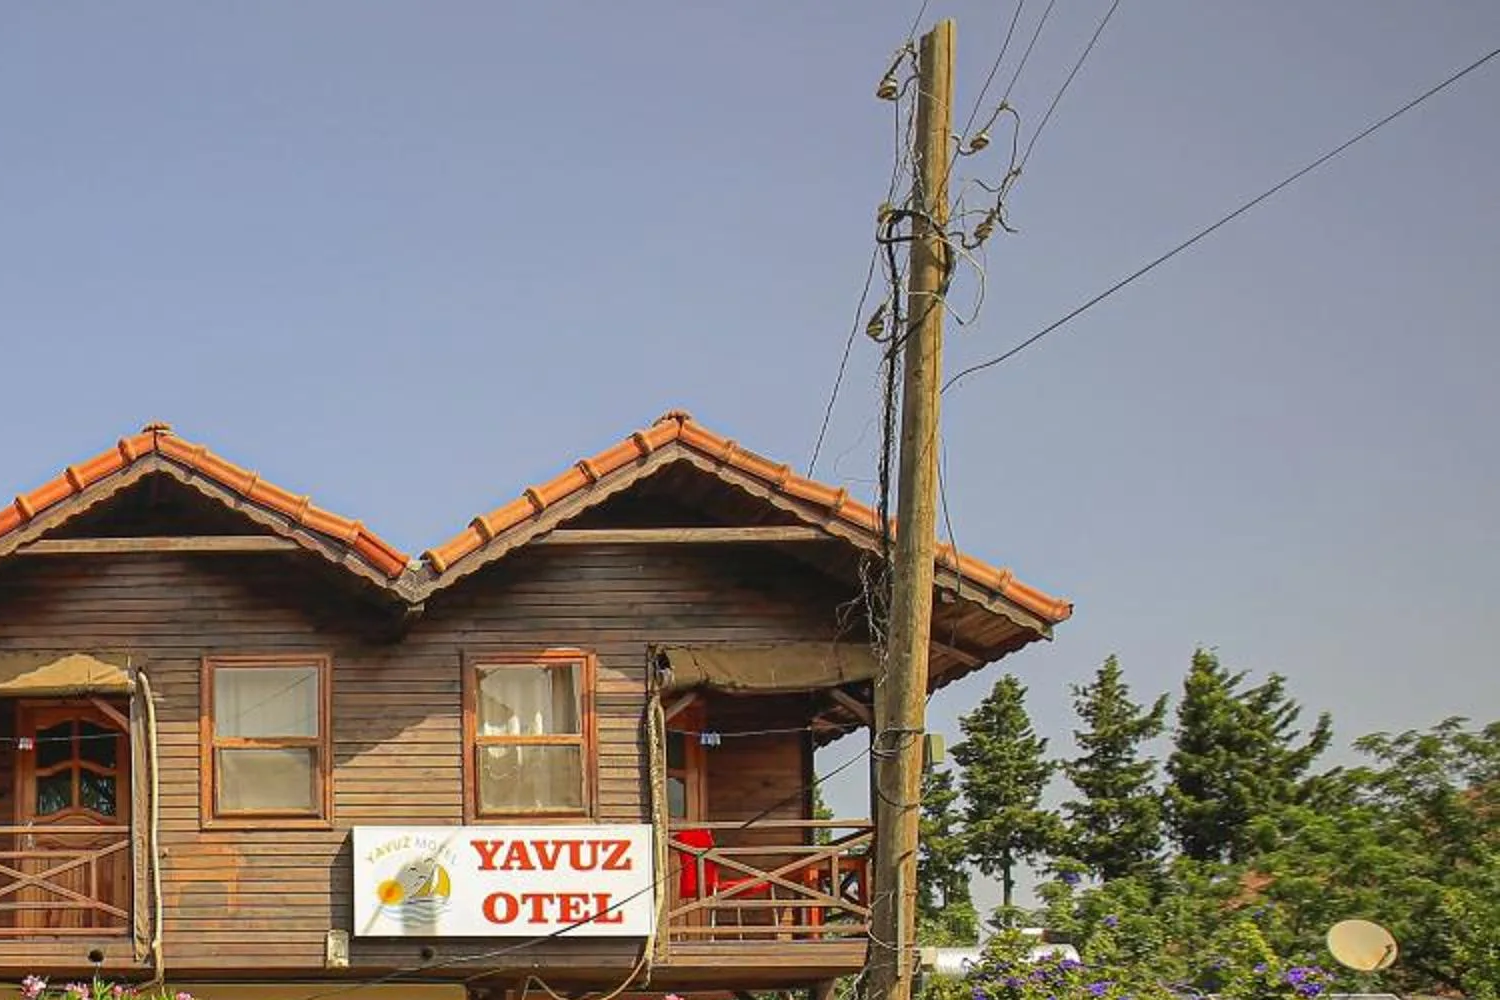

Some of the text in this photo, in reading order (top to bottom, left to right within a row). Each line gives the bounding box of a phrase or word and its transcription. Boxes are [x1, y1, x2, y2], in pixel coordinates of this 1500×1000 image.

[365, 835, 412, 864] YAVUZ
[470, 839, 632, 871] YAVUZ
[482, 893, 623, 924] OTEL
